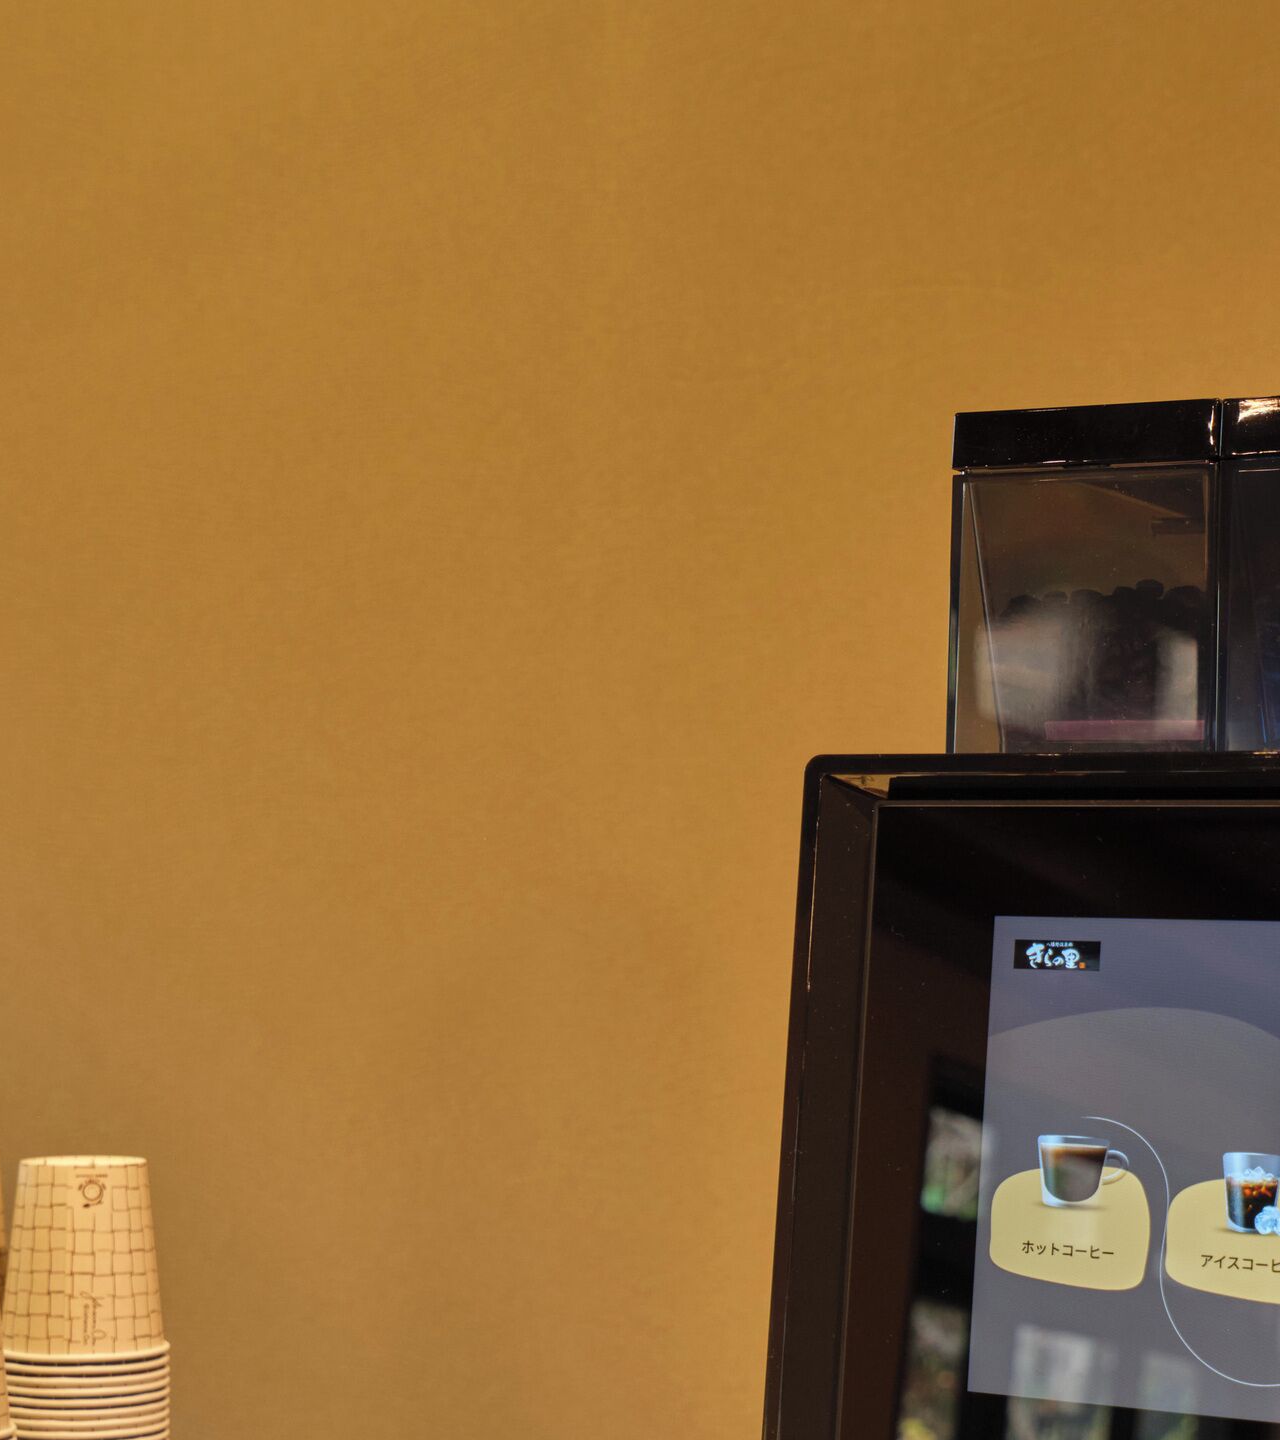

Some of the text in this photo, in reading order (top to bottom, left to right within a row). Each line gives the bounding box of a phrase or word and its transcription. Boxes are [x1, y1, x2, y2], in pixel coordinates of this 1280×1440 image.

[1021, 1240, 1115, 1260] ホットコーヒー
